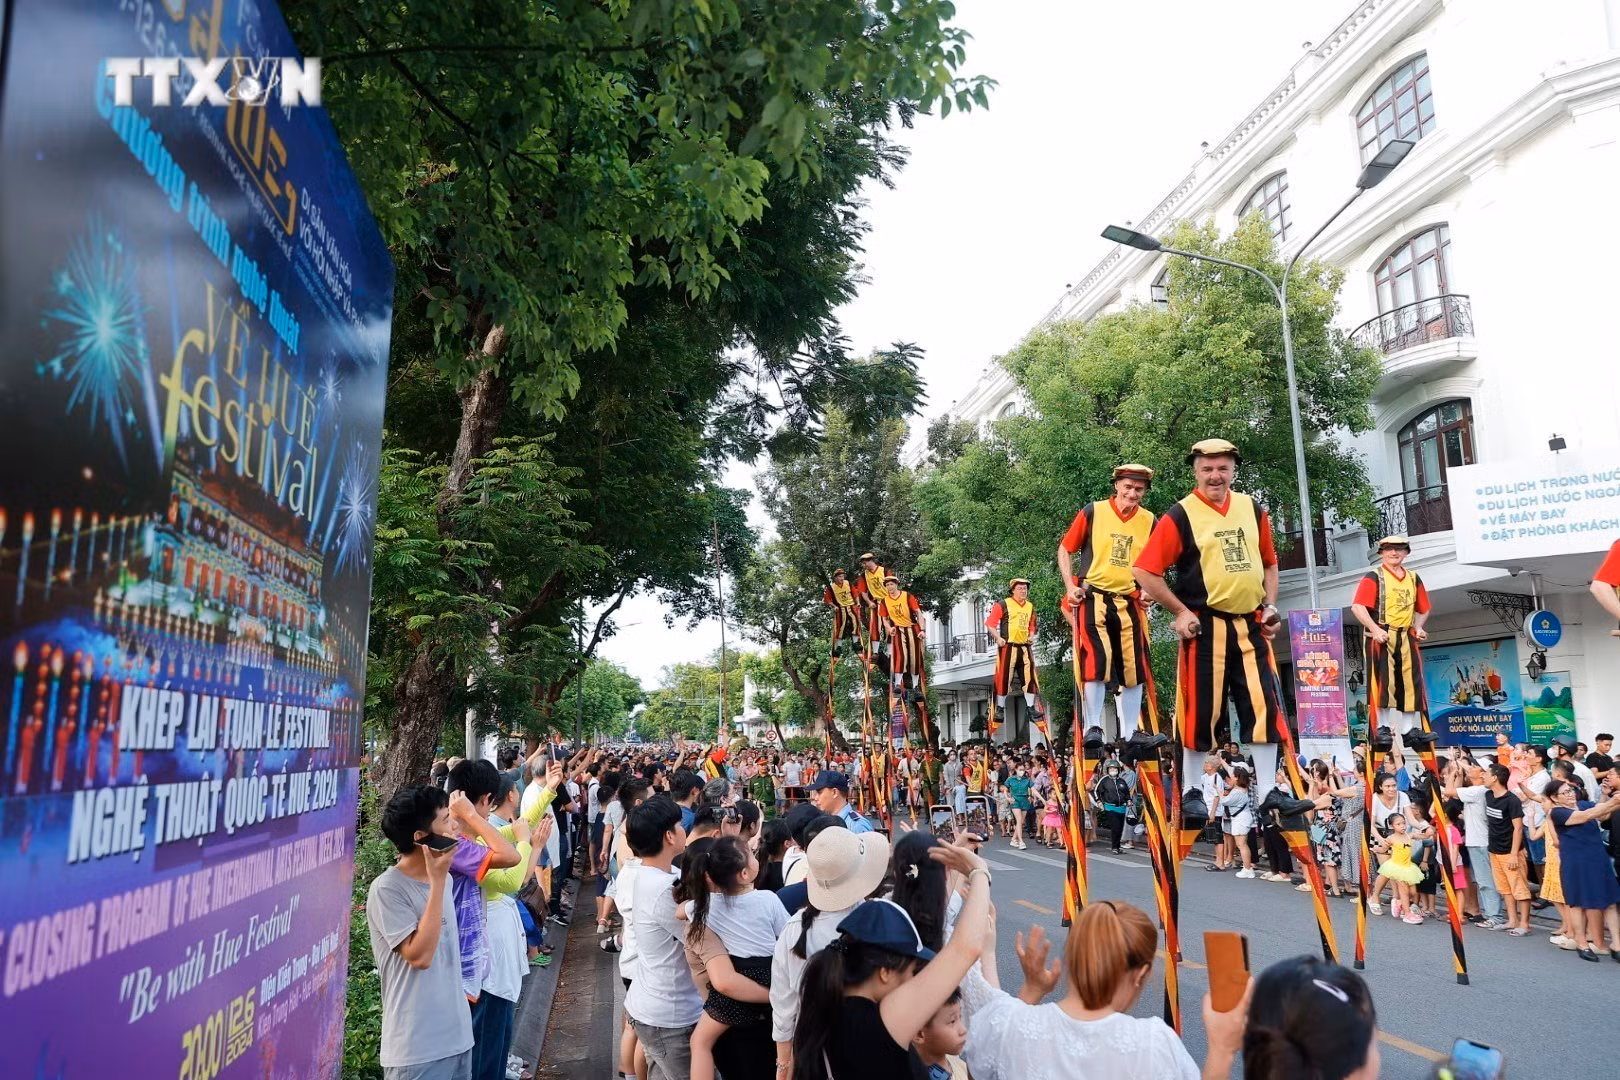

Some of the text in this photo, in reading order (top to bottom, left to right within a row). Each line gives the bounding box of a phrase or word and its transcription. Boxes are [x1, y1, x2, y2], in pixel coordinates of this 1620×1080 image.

[187, 180, 231, 268] trình
[232, 243, 268, 319] nghệ
[268, 289, 299, 356] thuật
[301, 187, 352, 291] DI SẢN VĂN HÓA
[160, 328, 318, 523] festival
[1485, 467, 1620, 496] DU LỊCH TRONG NƯỚ
[1487, 500, 1505, 511] DU
[1507, 496, 1538, 510] LỊCH
[1542, 490, 1582, 504] NƯỚC
[1489, 508, 1567, 526] VÉ MÁY BAY
[1491, 518, 1620, 542] ĐẶT PHÒNG KHÁCH
[119, 680, 331, 762] KHÉP LẠI TUẦN LỄ FESTIVAL
[1448, 716, 1463, 724] DỊCH
[1463, 716, 1473, 724] VỤ
[1483, 713, 1497, 722] MÁY
[1500, 714, 1513, 722] BAY
[1449, 724, 1467, 733] QUỐC
[1468, 724, 1480, 733] NỘI
[1505, 722, 1513, 732] TẾ
[68, 757, 339, 866] NGHỆ THUẬT QUỐC TẾ HUẾ 2024
[4, 902, 96, 998] CLOSING
[97, 879, 173, 959] PROGRAM
[173, 874, 191, 929] OF
[189, 867, 213, 923] HUE
[211, 847, 275, 913] INTERNATIONAL
[291, 833, 318, 879] FESTIVAL
[120, 894, 300, 1024] "Be with Hue Festival"
[226, 1027, 254, 1067] 2024
